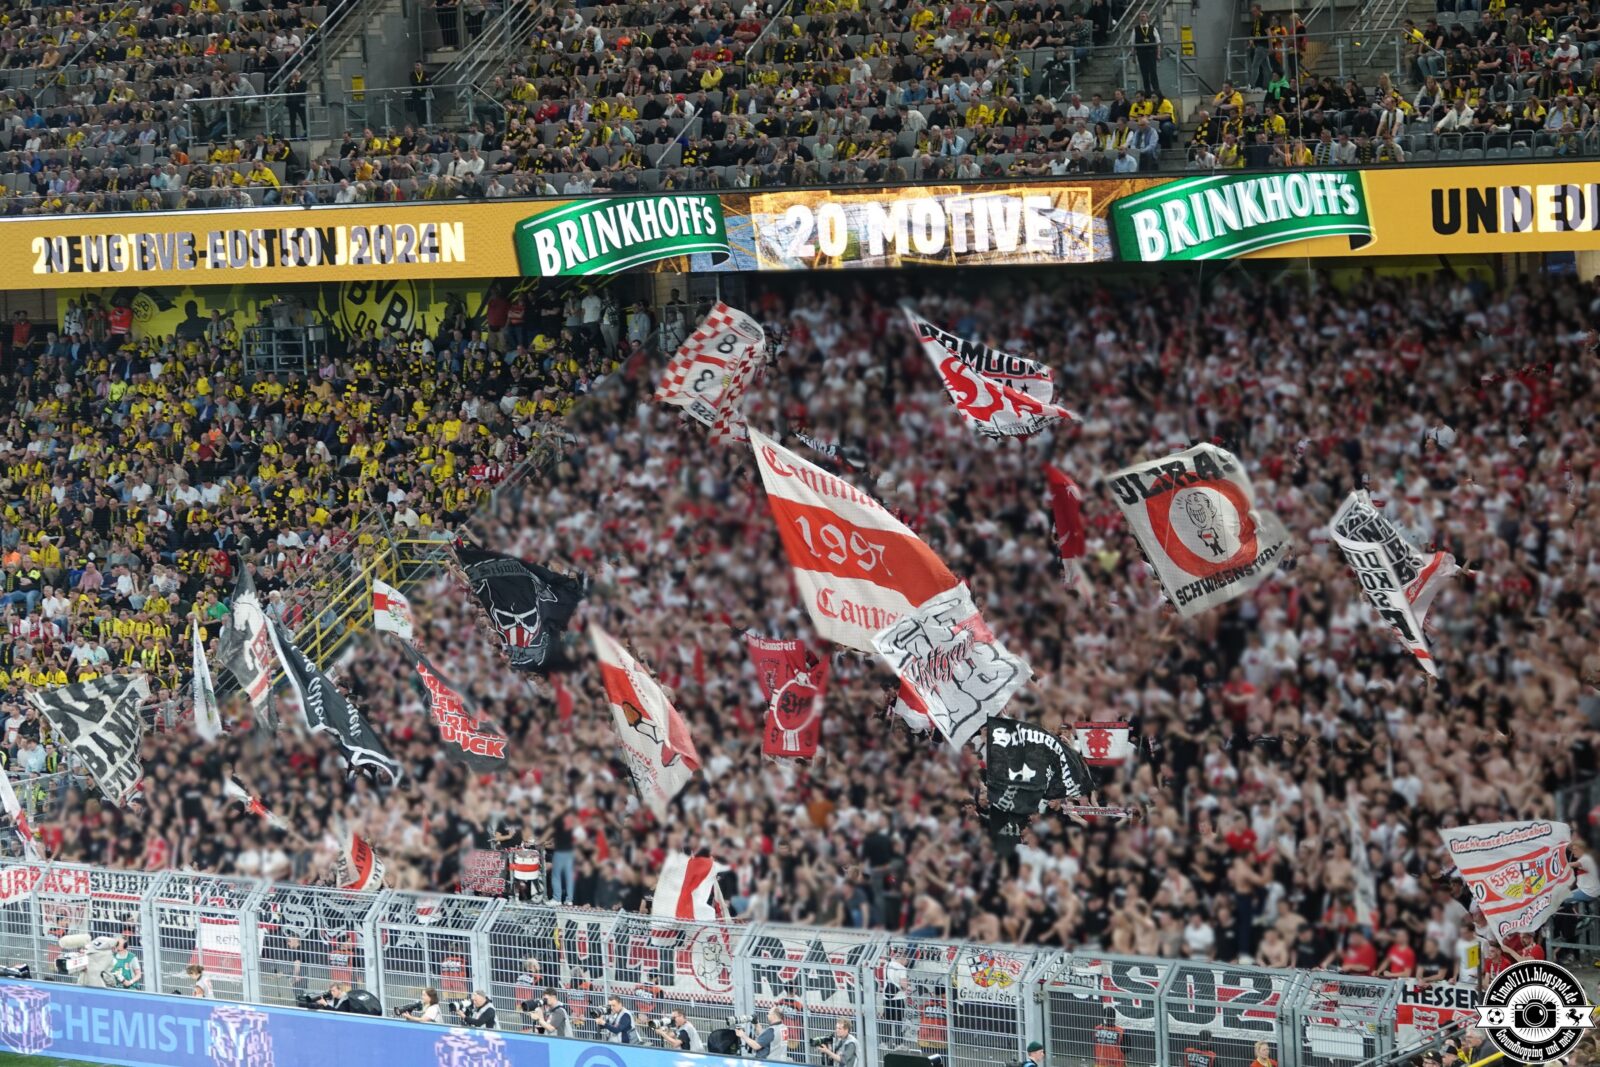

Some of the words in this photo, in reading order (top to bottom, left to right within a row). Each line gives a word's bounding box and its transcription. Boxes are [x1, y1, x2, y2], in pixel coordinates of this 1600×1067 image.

[533, 195, 718, 277] BRINKHOFF's
[868, 195, 1059, 256] MOTIVE
[1132, 172, 1361, 261] BRINKHOFF's
